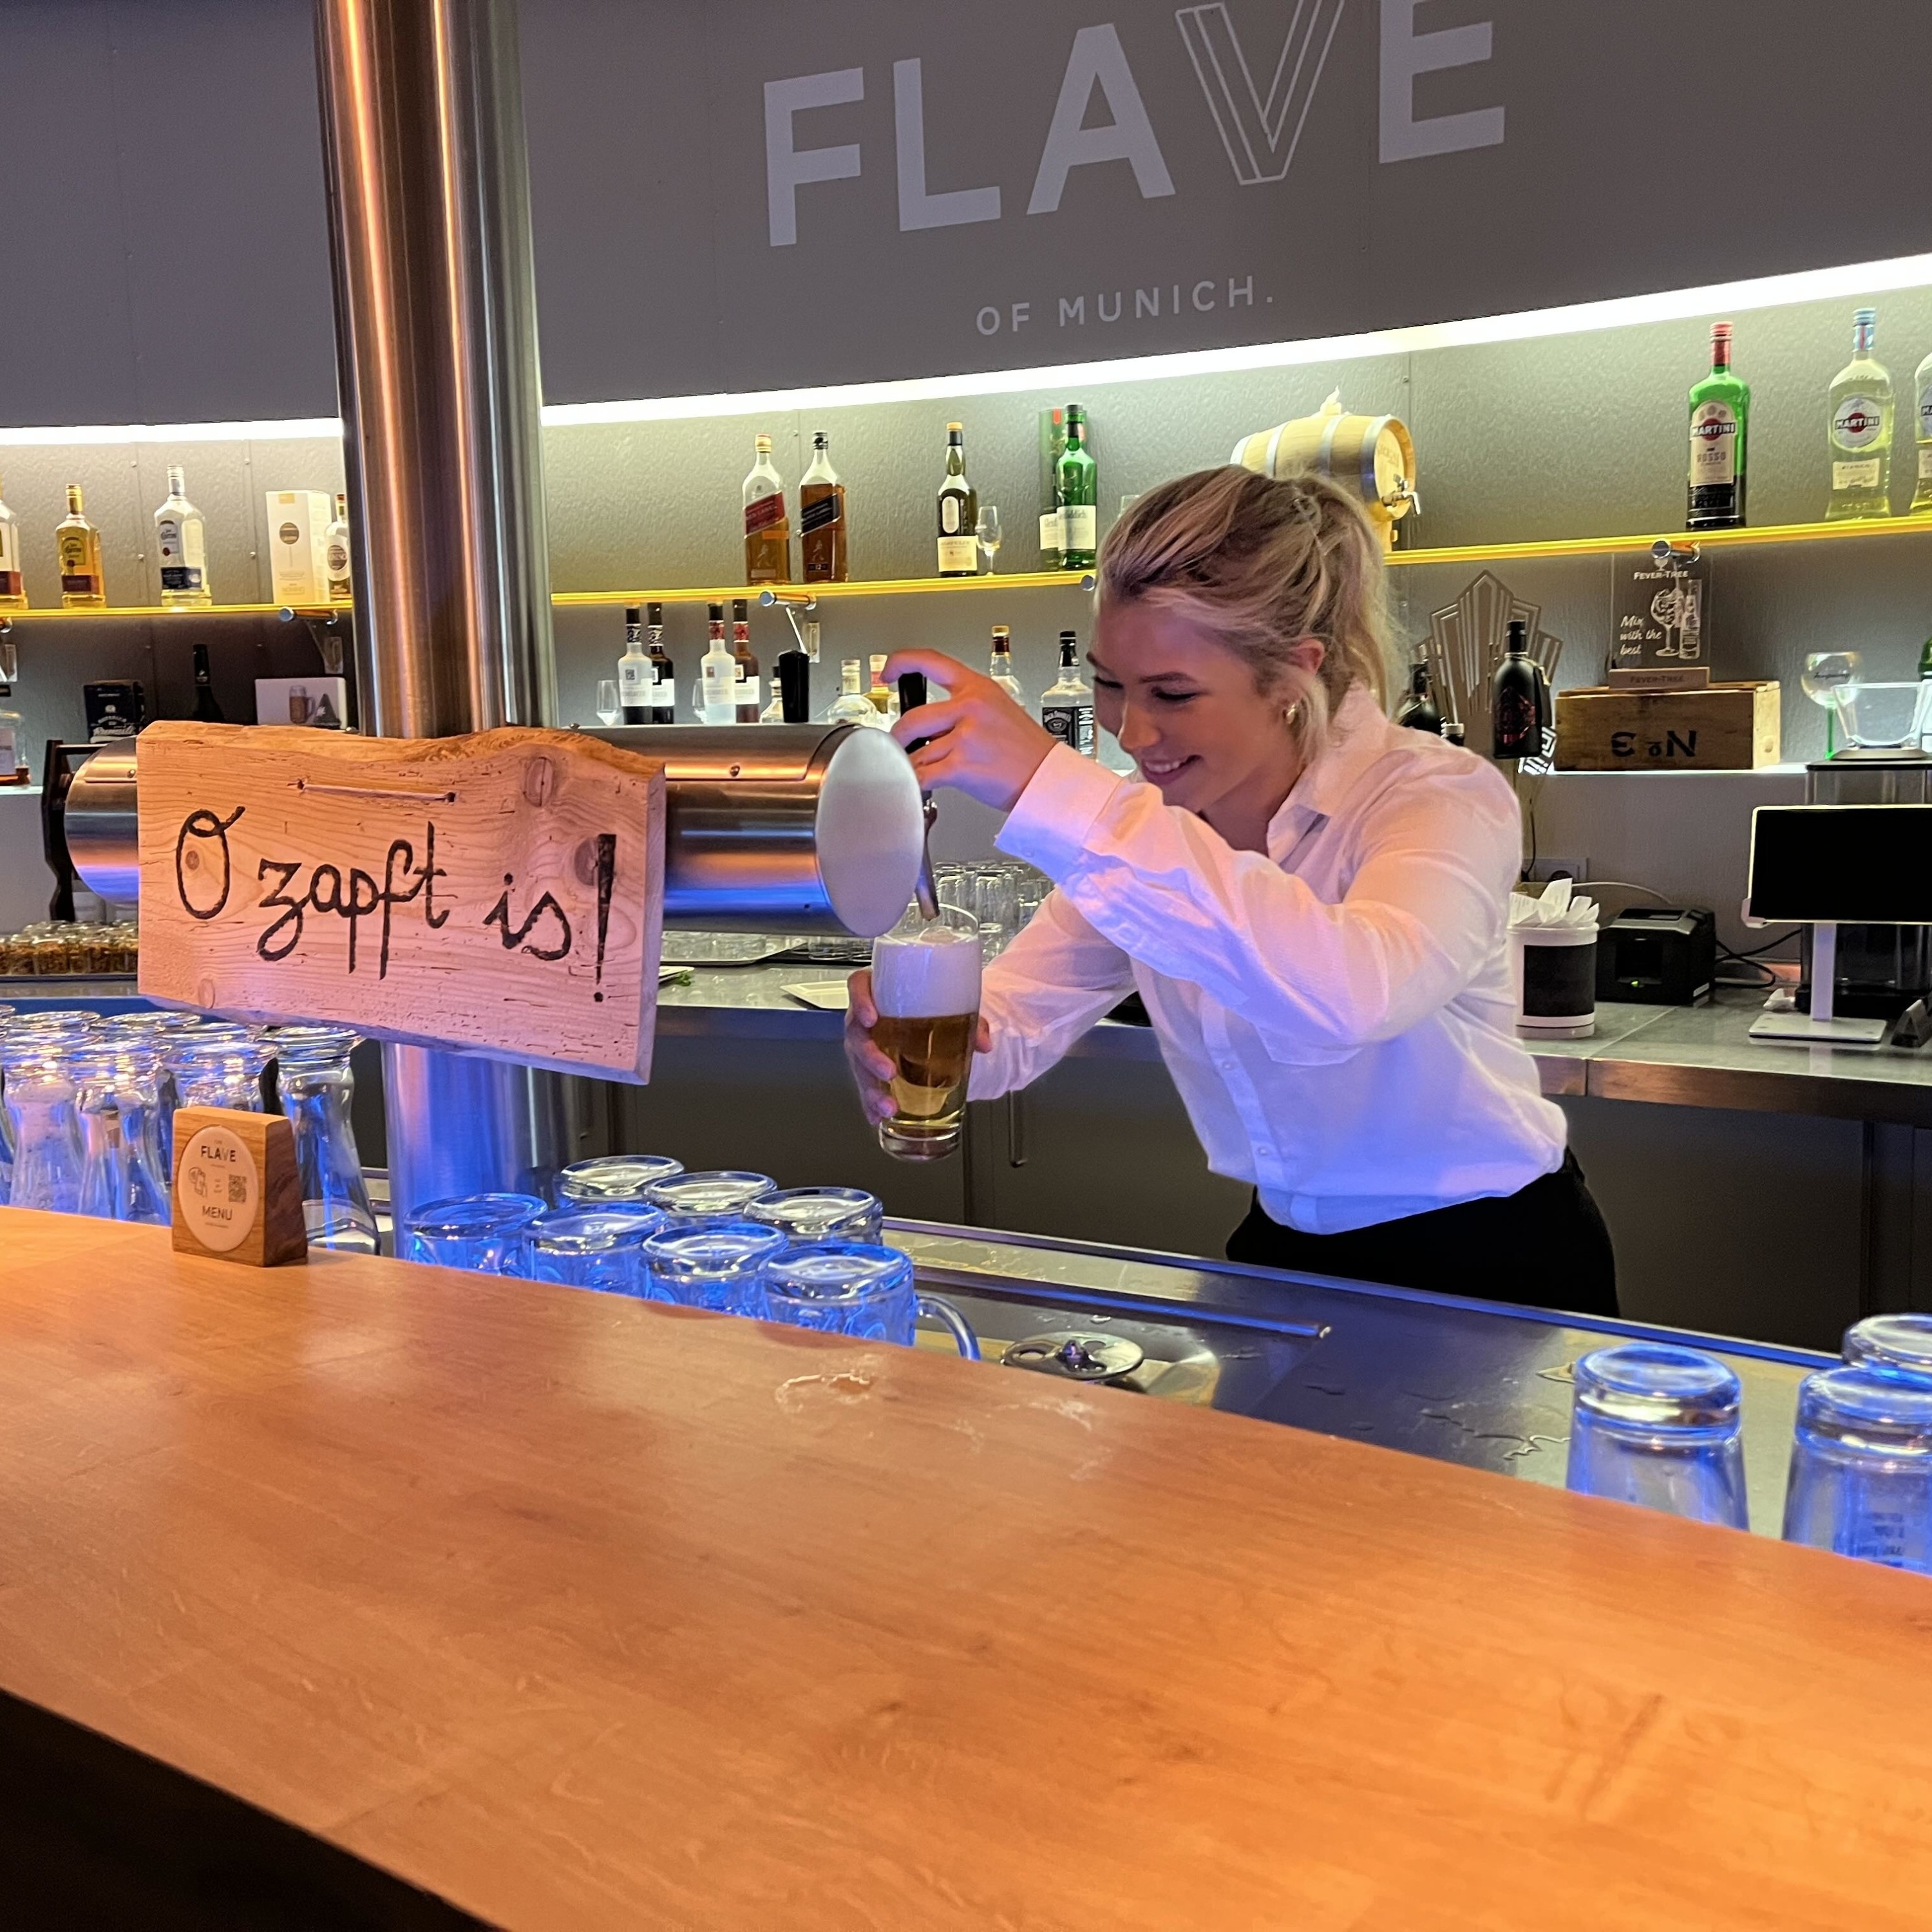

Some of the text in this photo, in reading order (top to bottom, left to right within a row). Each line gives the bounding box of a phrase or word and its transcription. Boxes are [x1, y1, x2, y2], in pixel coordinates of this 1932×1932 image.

[764, 0, 1505, 246] FLAVE
[976, 275, 1274, 336] OF MUNICH.
[1692, 422, 1735, 437] MARTINI
[1835, 416, 1880, 430] MARTINI
[1634, 571, 1689, 580] FEVER-TREE
[1620, 616, 1644, 628] Mix
[1620, 629, 1662, 640] with the
[1620, 644, 1642, 656] best
[257, 821, 450, 980] zapft
[483, 833, 617, 1003] is!
[200, 1146, 236, 1162] FLAVE
[202, 1206, 232, 1220] MENU
